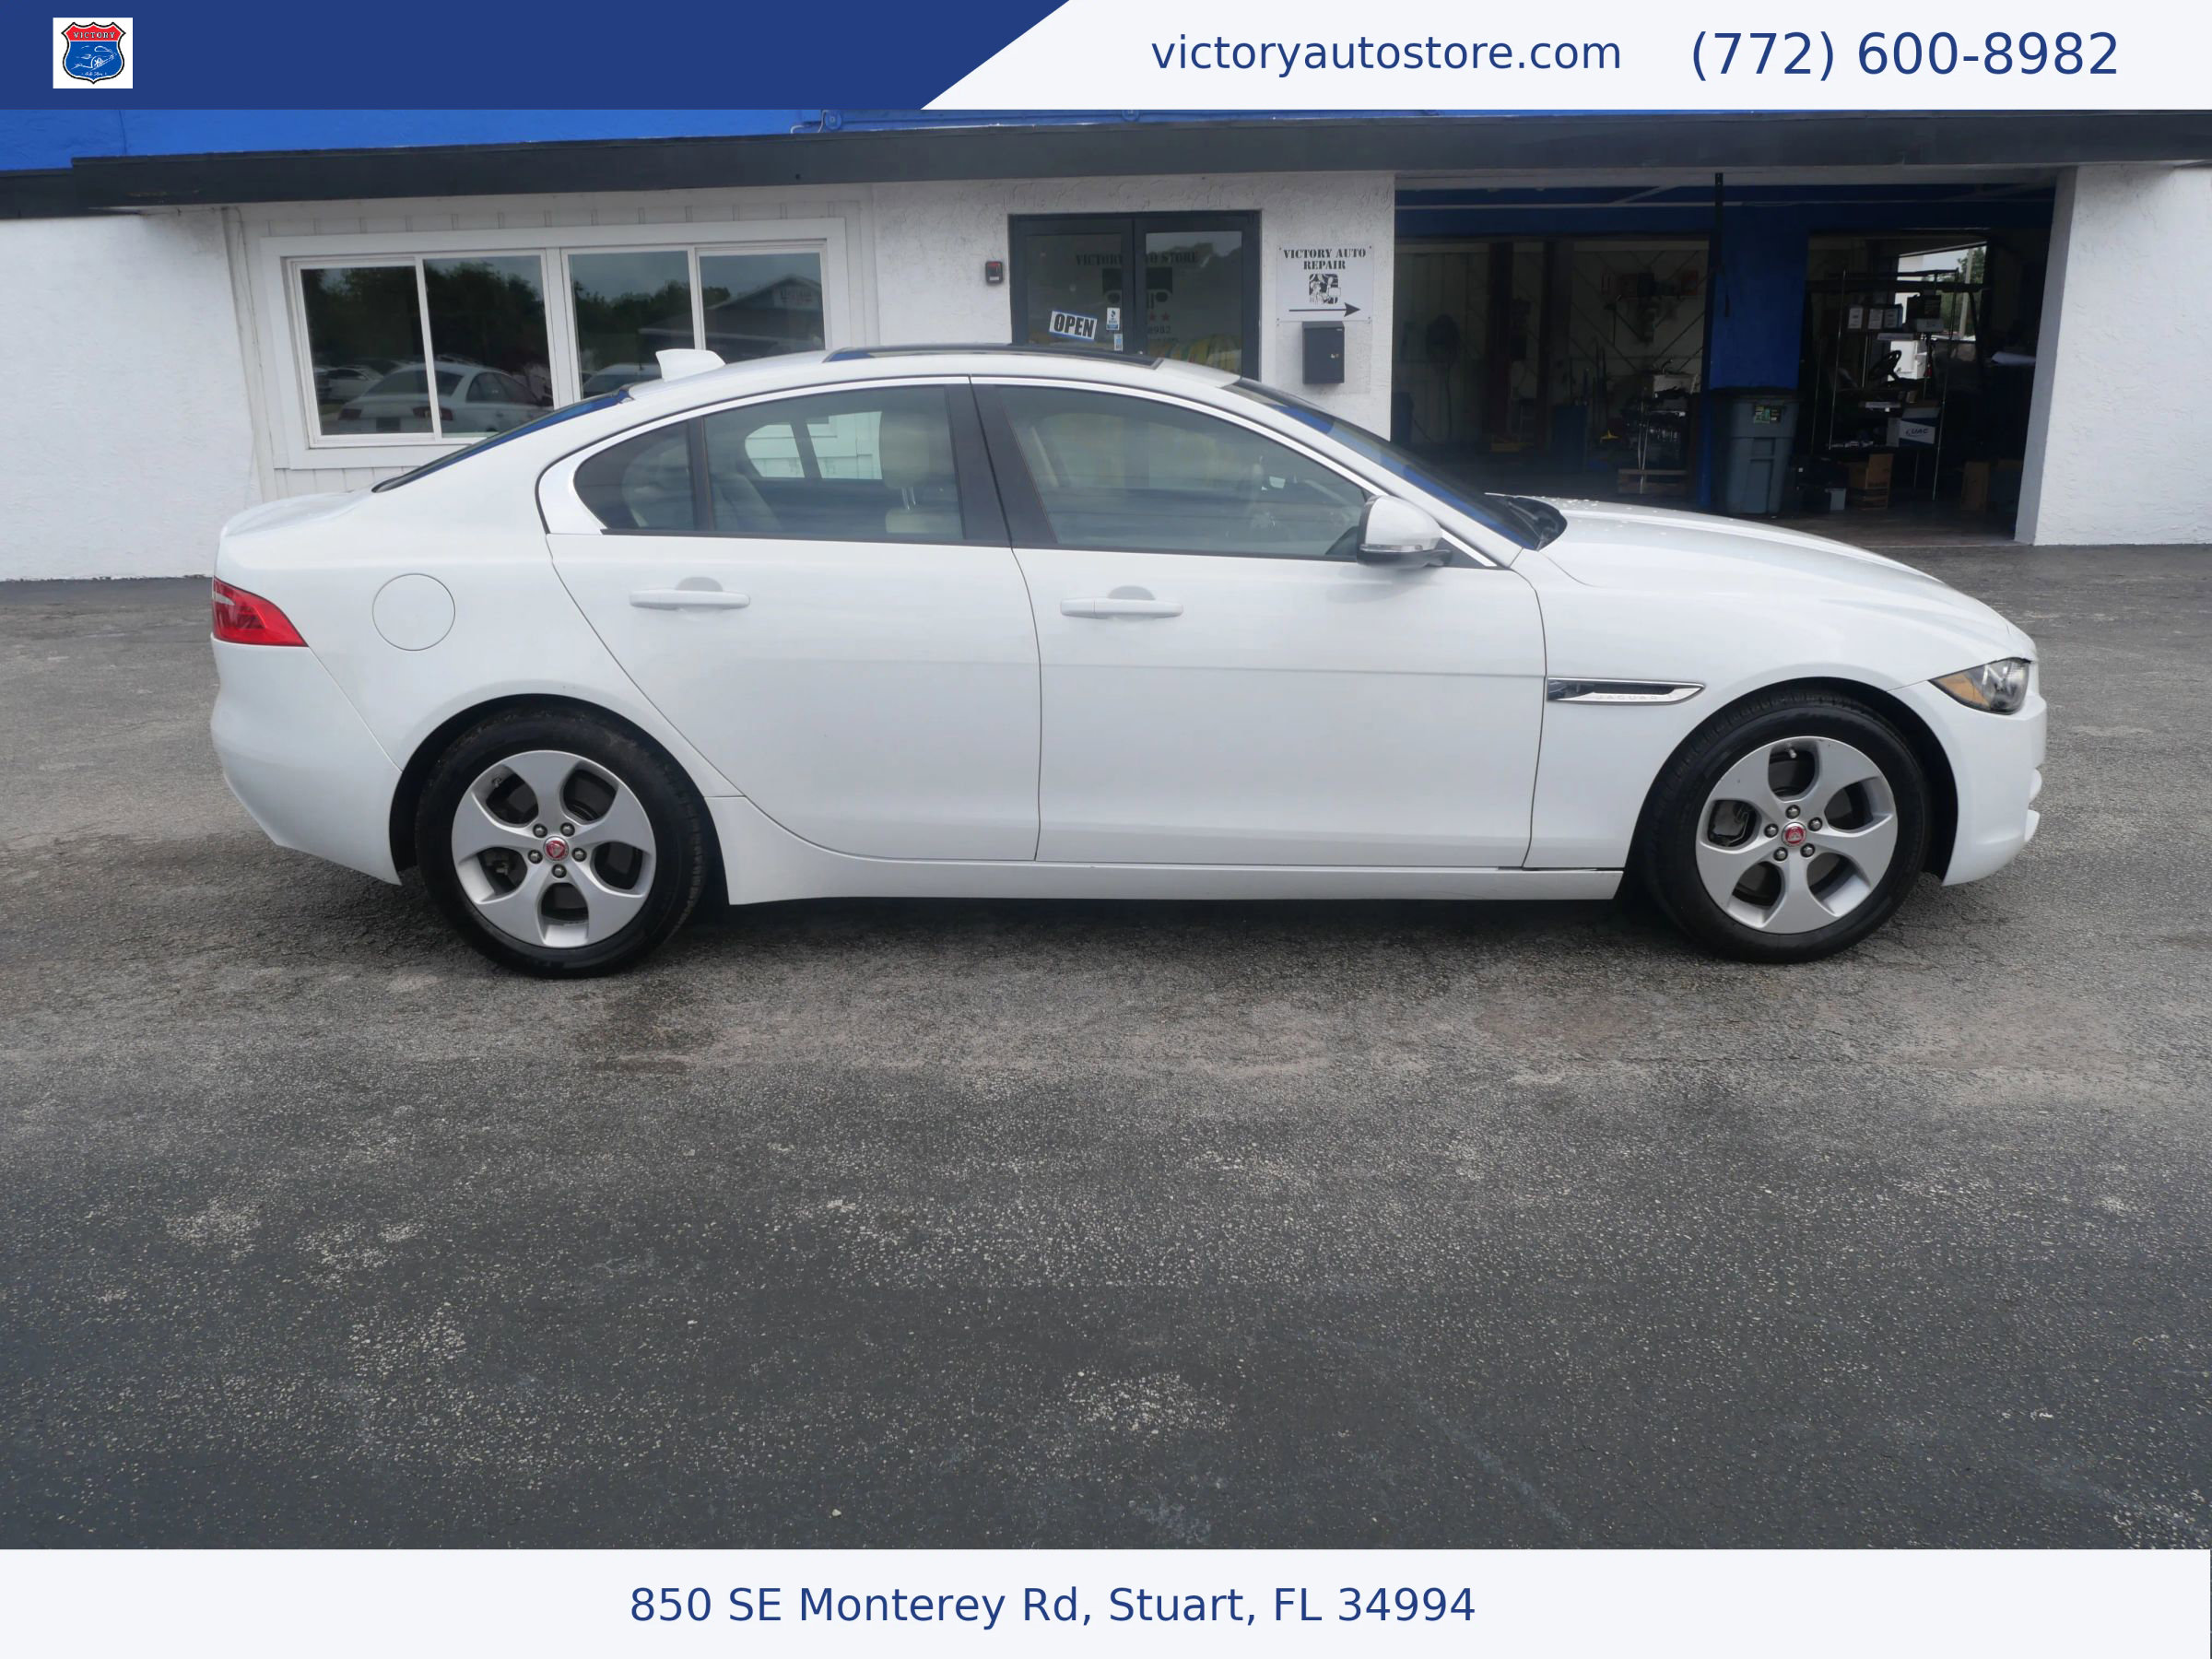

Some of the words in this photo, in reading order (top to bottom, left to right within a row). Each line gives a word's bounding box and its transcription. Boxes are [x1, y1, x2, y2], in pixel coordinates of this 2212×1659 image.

[1076, 253, 1123, 265] VICTORY
[1161, 252, 1197, 264] STORE
[1284, 248, 1332, 259] VICTORY
[1335, 248, 1366, 258] AUTO
[1303, 260, 1346, 270] REPAIR
[1053, 313, 1095, 338] OPEN
